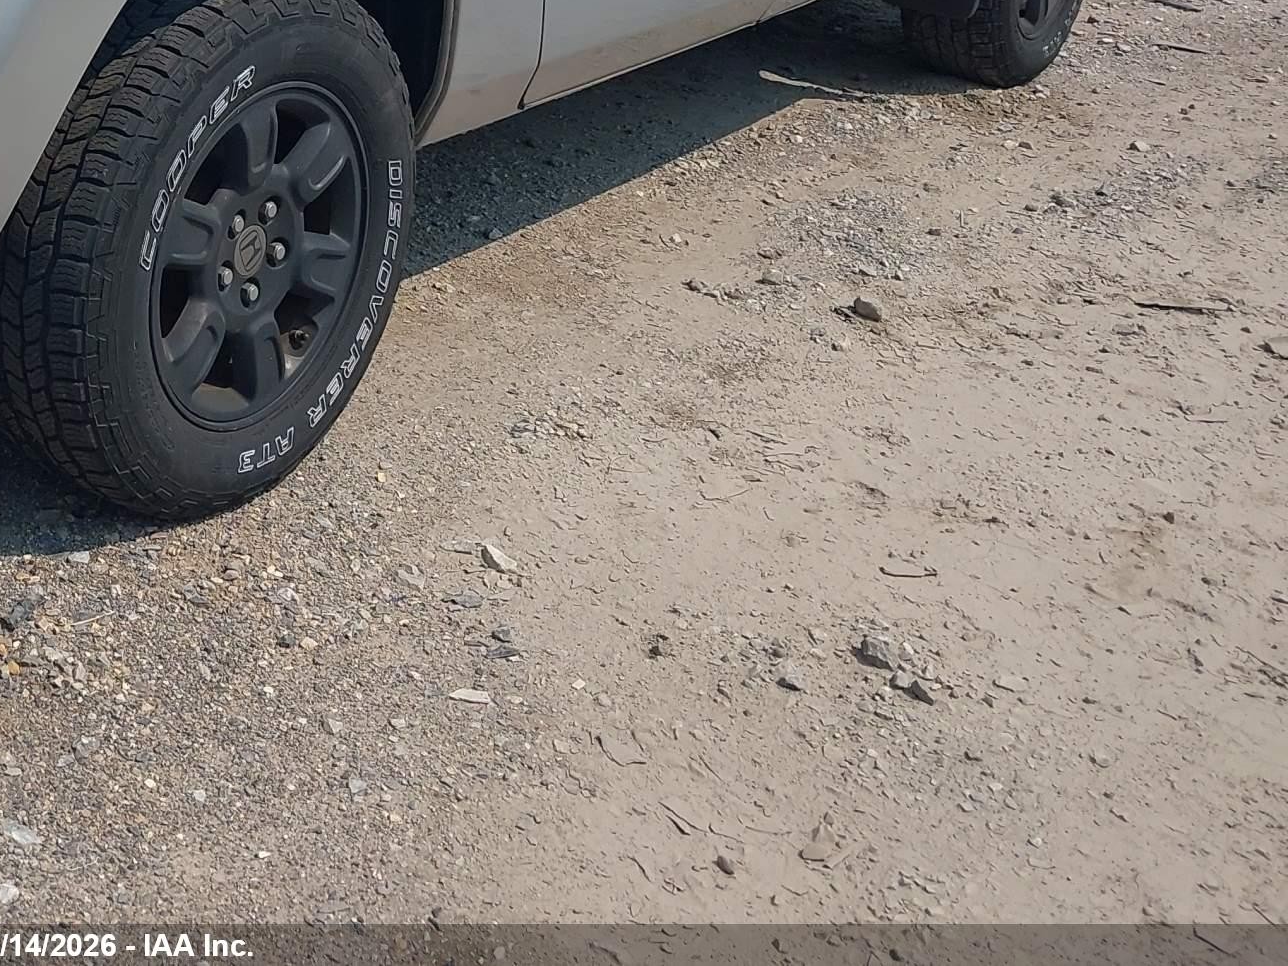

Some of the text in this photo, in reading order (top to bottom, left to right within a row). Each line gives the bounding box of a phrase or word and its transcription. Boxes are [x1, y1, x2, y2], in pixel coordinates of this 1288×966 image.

[141, 66, 256, 271] COOPER
[237, 160, 402, 474] DISCOVERER AT3
